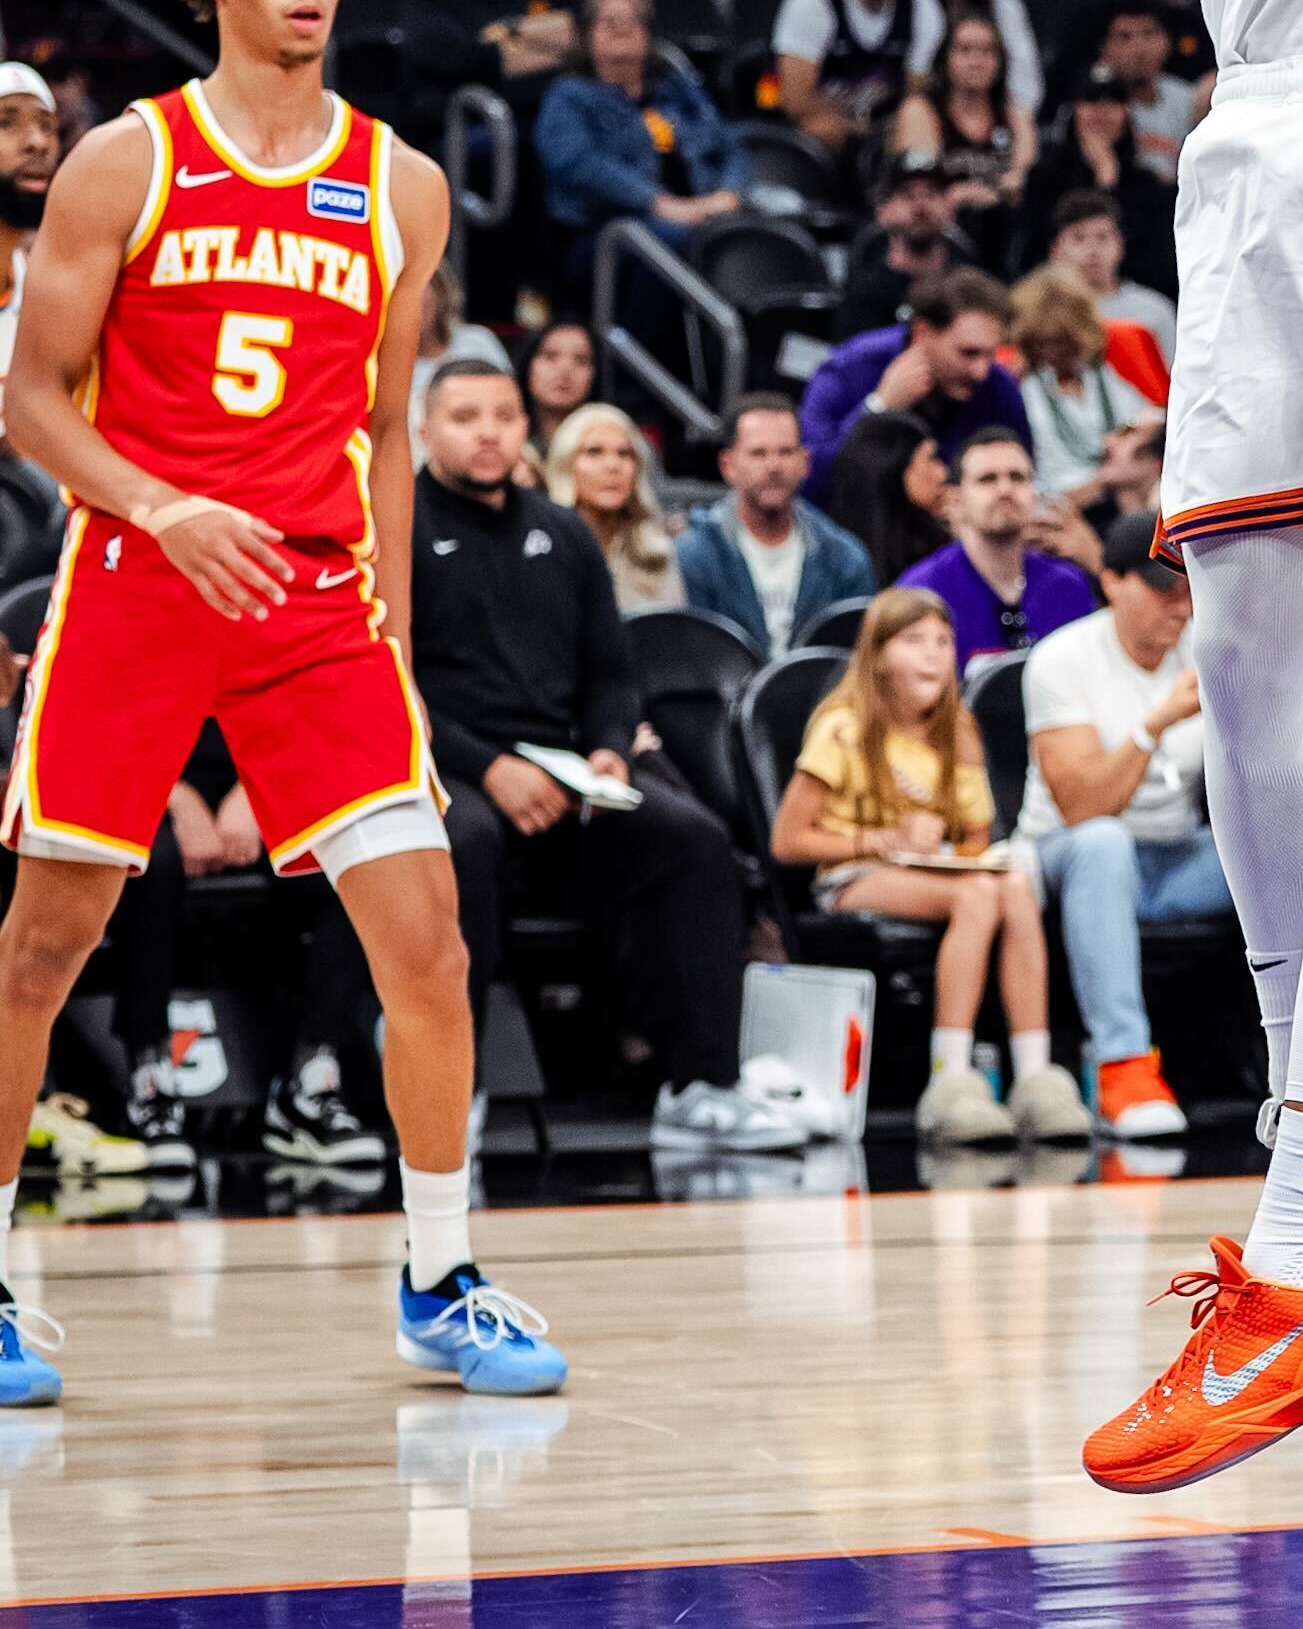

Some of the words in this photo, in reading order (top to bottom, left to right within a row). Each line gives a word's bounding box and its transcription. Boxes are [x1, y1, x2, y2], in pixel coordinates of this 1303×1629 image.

[313, 187, 364, 211] paze
[150, 224, 370, 316] ATLANTA
[211, 310, 294, 419] 5
